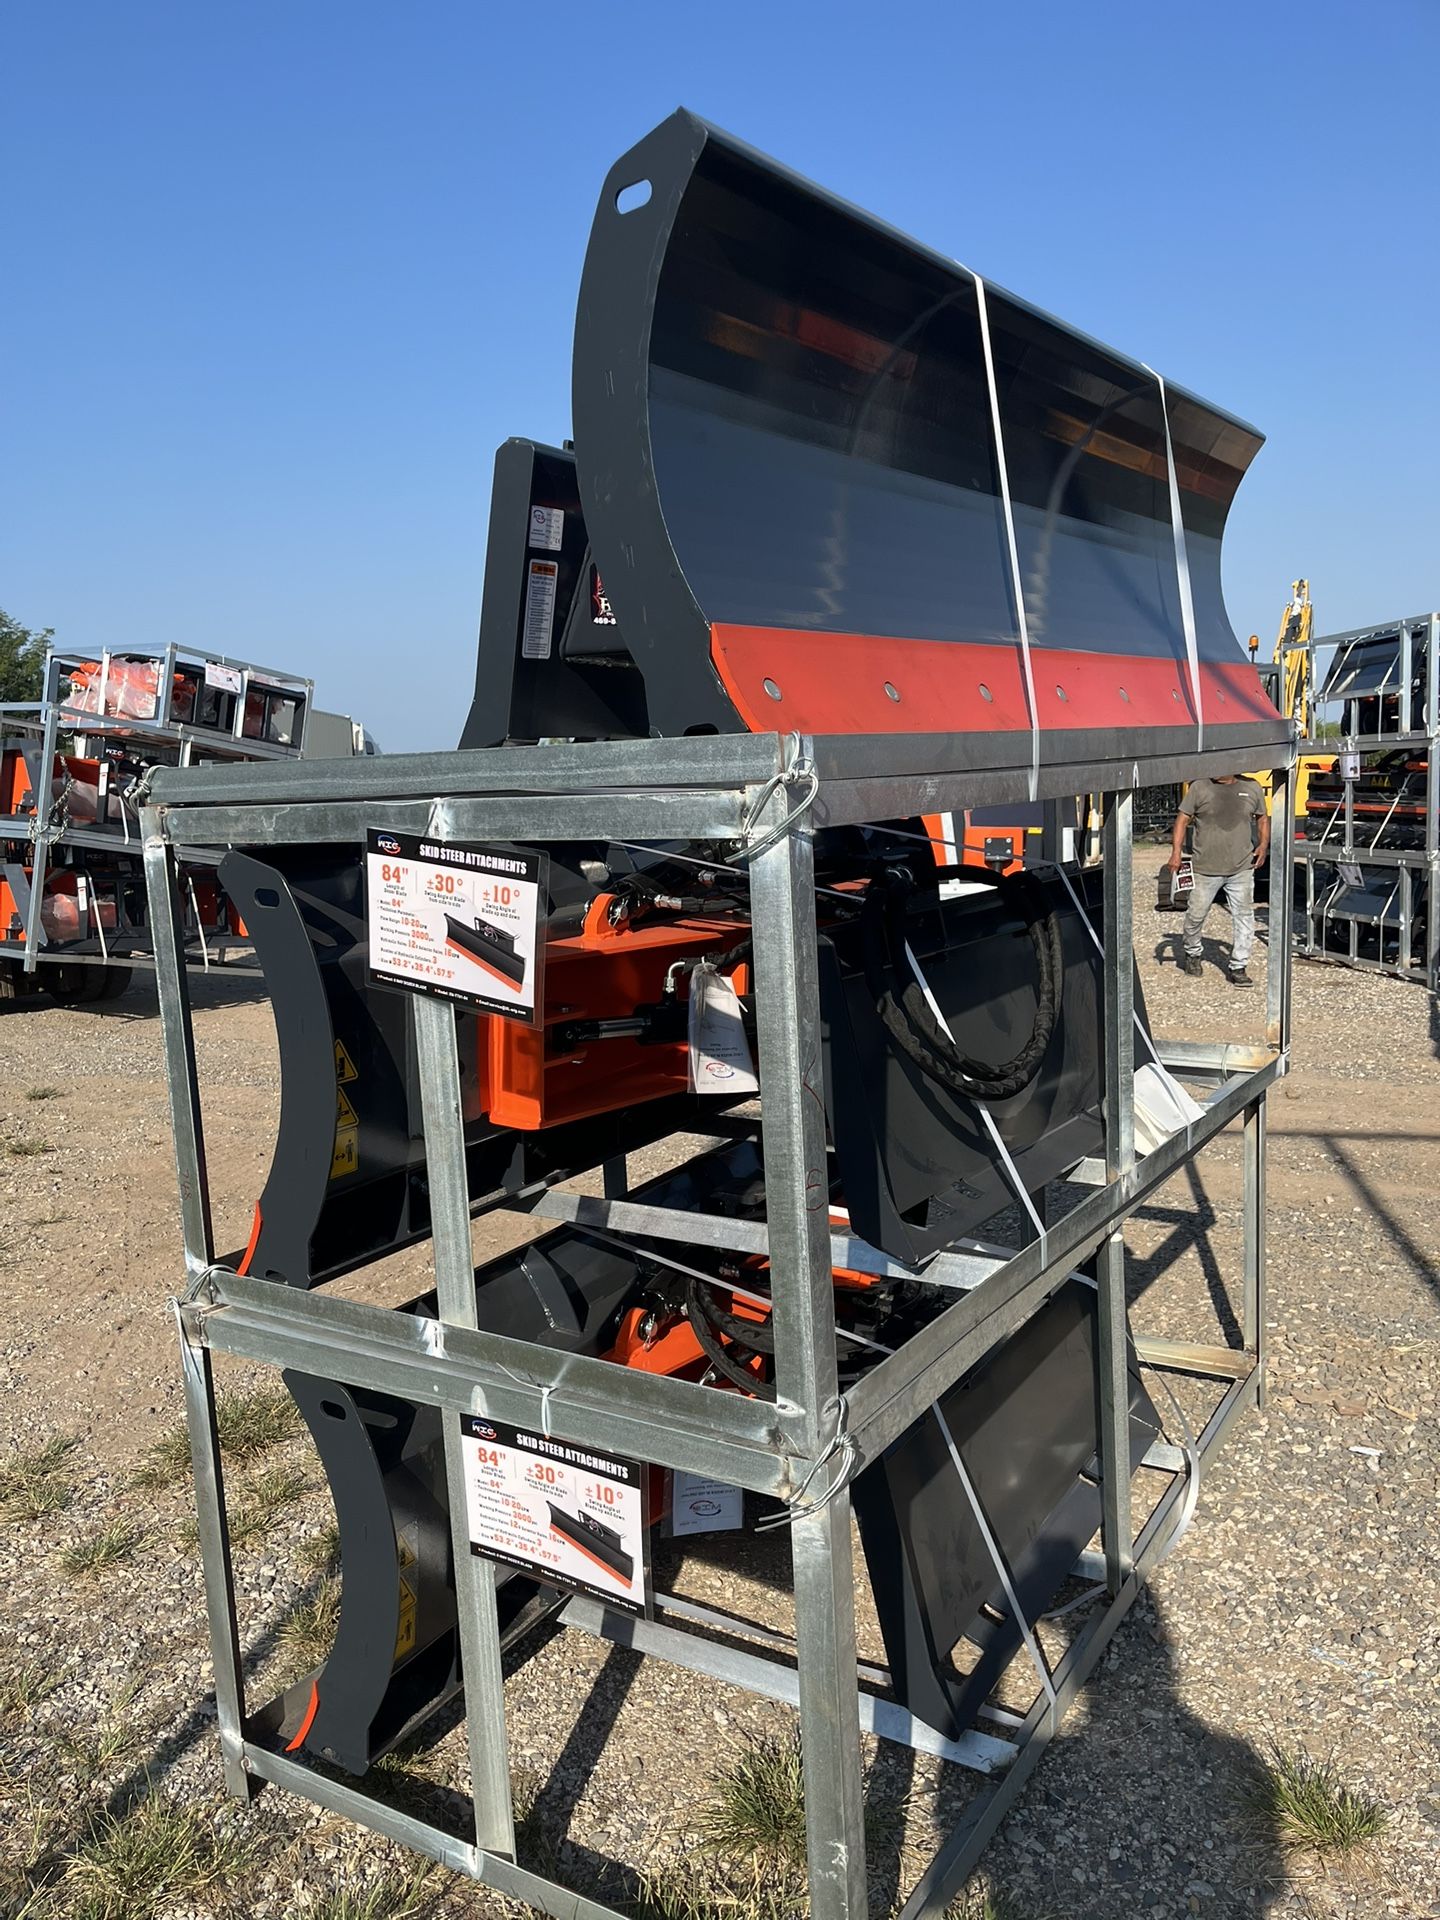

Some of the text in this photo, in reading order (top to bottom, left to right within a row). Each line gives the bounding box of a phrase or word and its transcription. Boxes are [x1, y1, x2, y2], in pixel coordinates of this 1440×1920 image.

[419, 843, 527, 875] SKID STEER ATTACHMENTS
[382, 864, 408, 884] 84"
[478, 1447, 506, 1467] 84"
[516, 1433, 629, 1479] SKID STEER ATTACHMENTS
